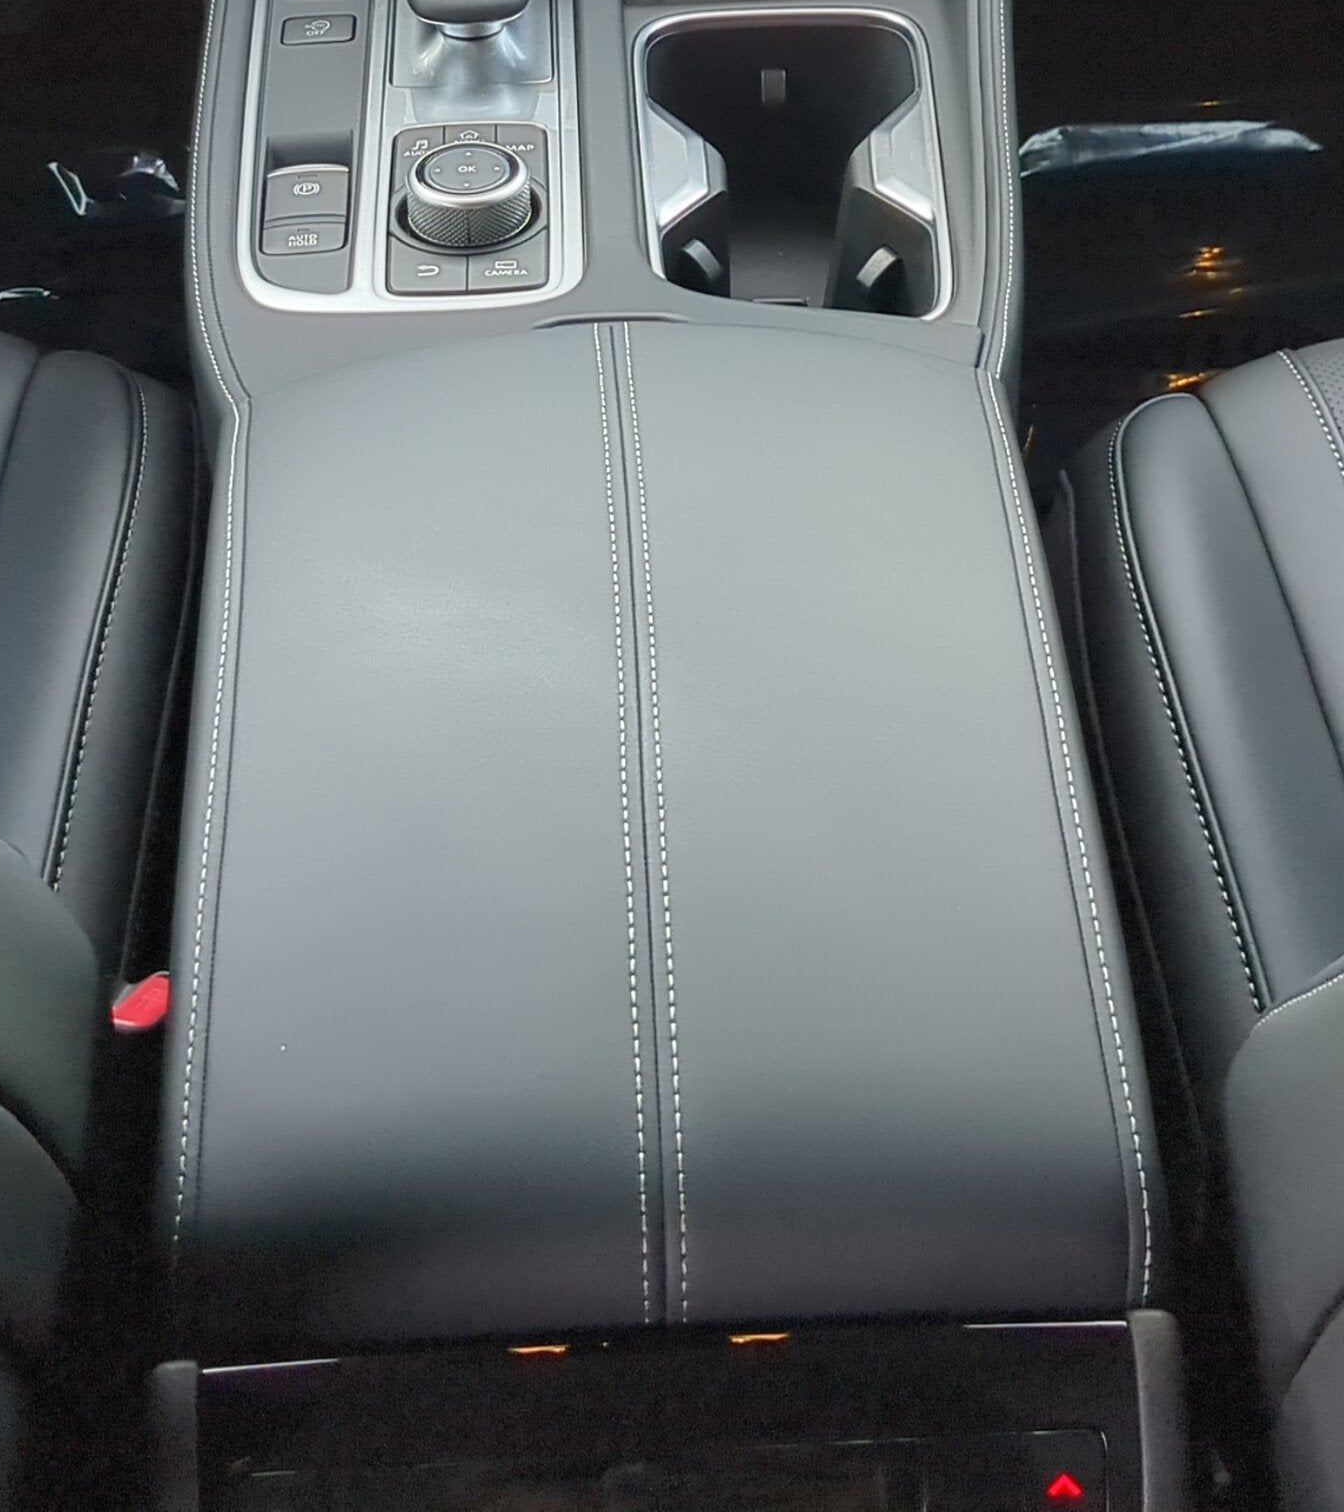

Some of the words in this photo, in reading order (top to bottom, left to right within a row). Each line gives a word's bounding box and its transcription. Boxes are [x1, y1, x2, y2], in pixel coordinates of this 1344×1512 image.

[457, 165, 477, 174] OK
[288, 233, 318, 241] AUTO
[287, 239, 318, 247] HOLD
[484, 268, 528, 277] CAMERA
